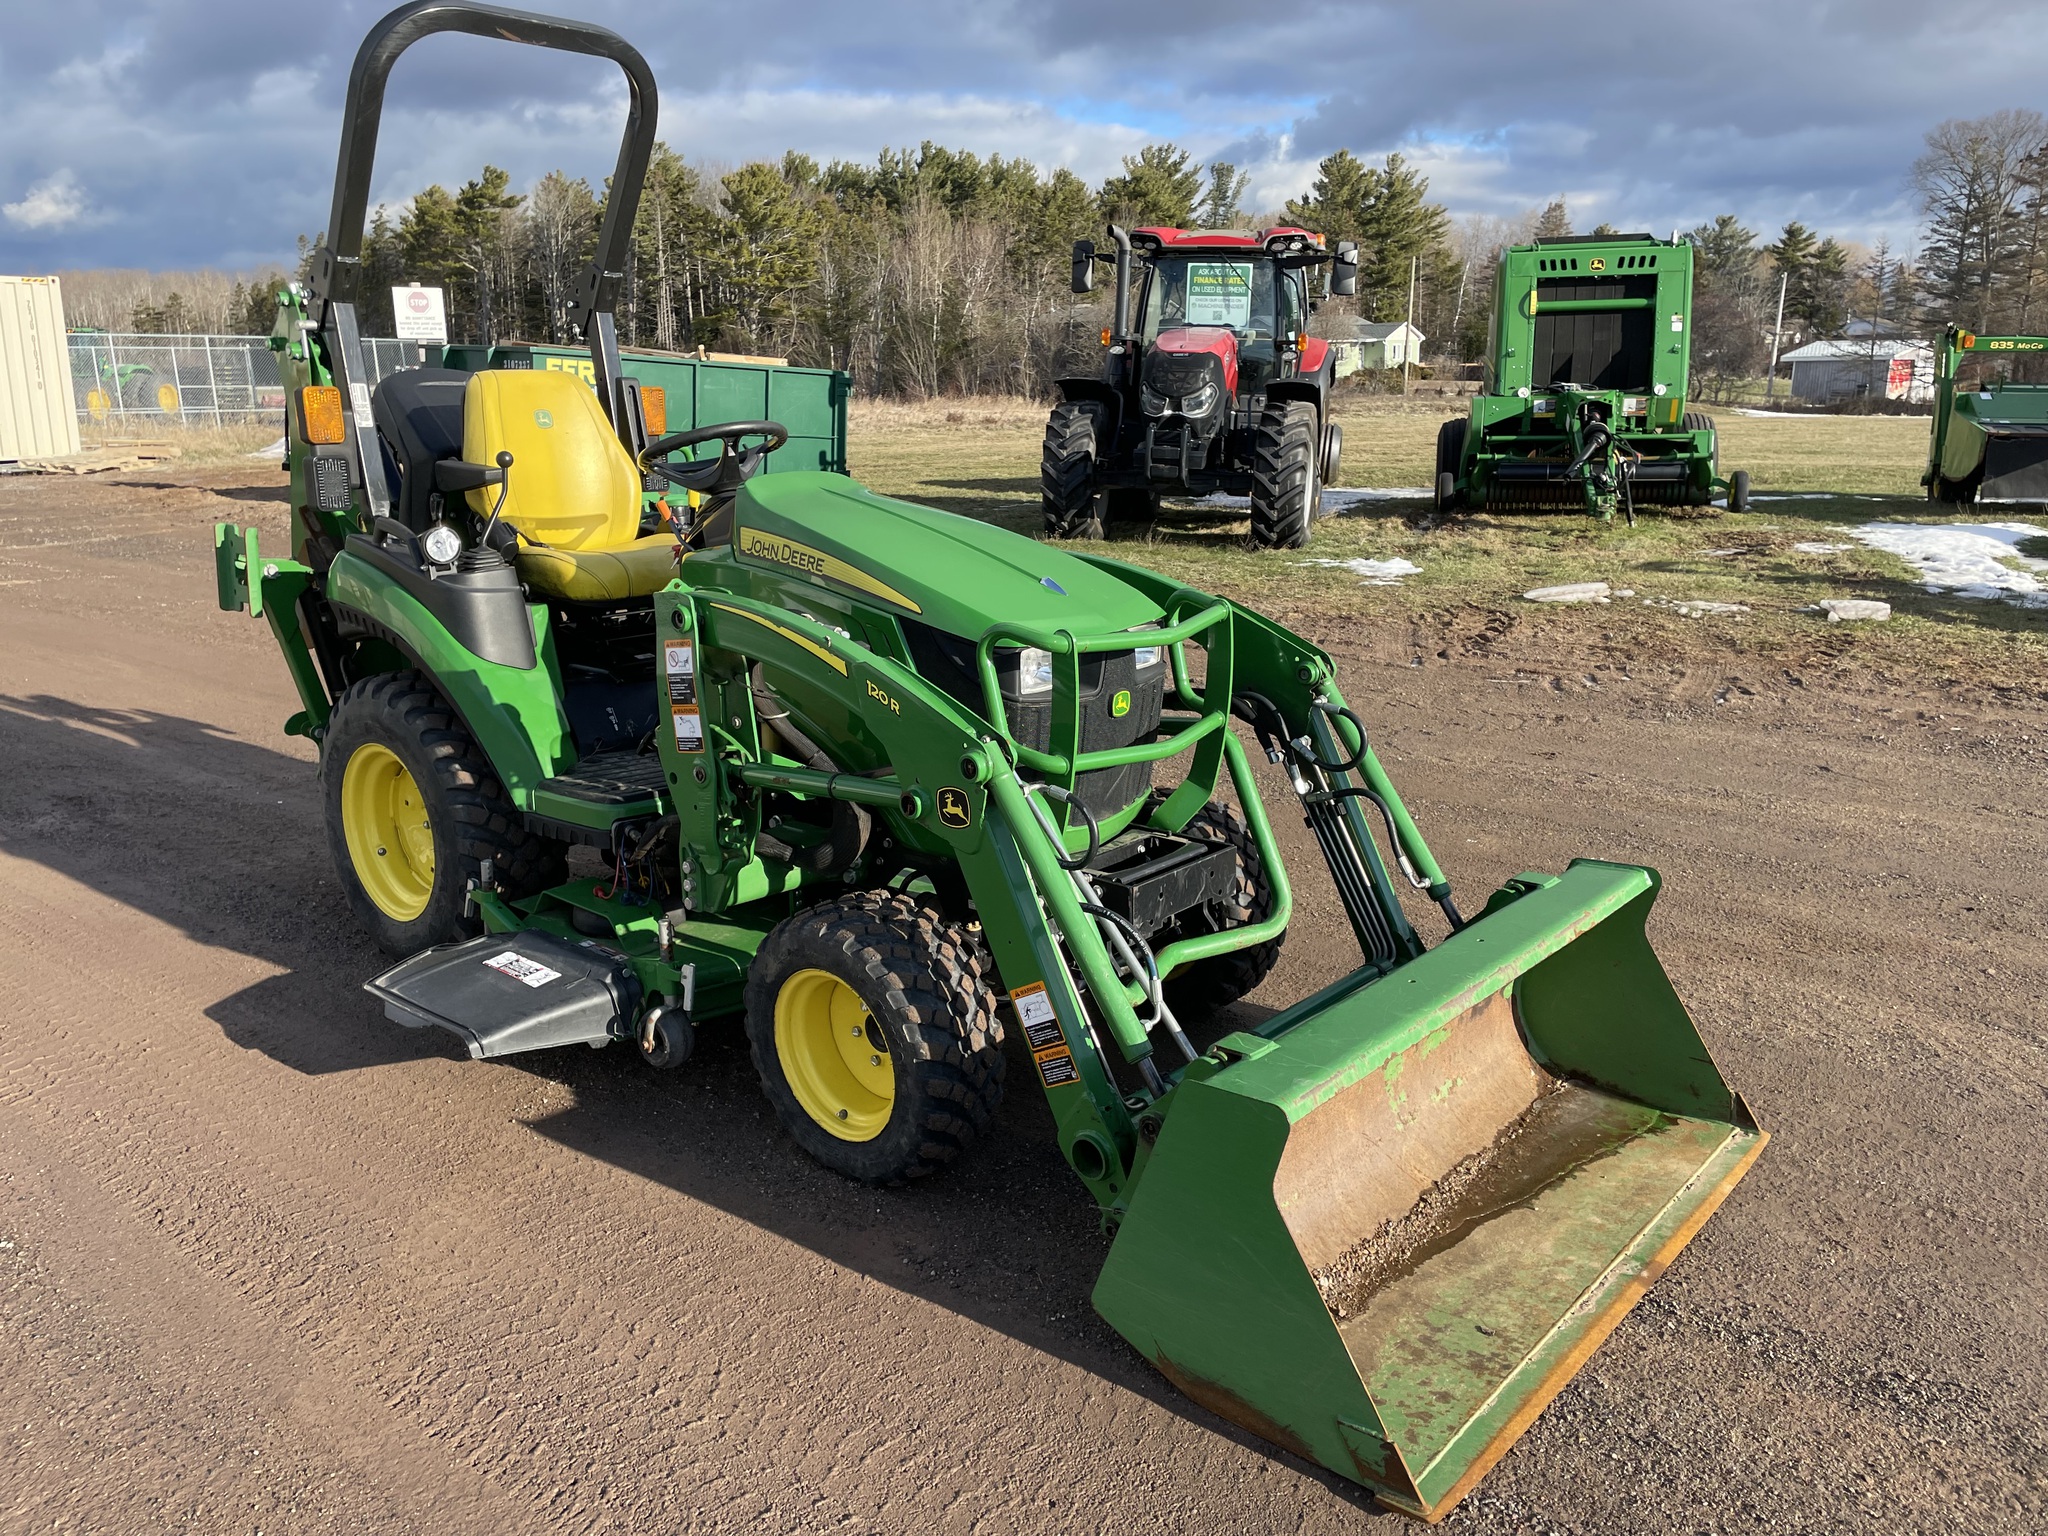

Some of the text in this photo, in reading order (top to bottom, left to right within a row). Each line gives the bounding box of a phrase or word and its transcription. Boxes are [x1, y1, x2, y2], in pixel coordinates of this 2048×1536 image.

[409, 299, 428, 307] STOP
[1990, 341, 2044, 350] 835 MoCo
[746, 536, 826, 574] JOHN DEERE
[669, 640, 691, 648] WARNING
[866, 679, 900, 717] 120 R
[676, 707, 699, 715] WARNING
[1020, 984, 1042, 996] WARNING
[1043, 1048, 1067, 1060] WARNING
